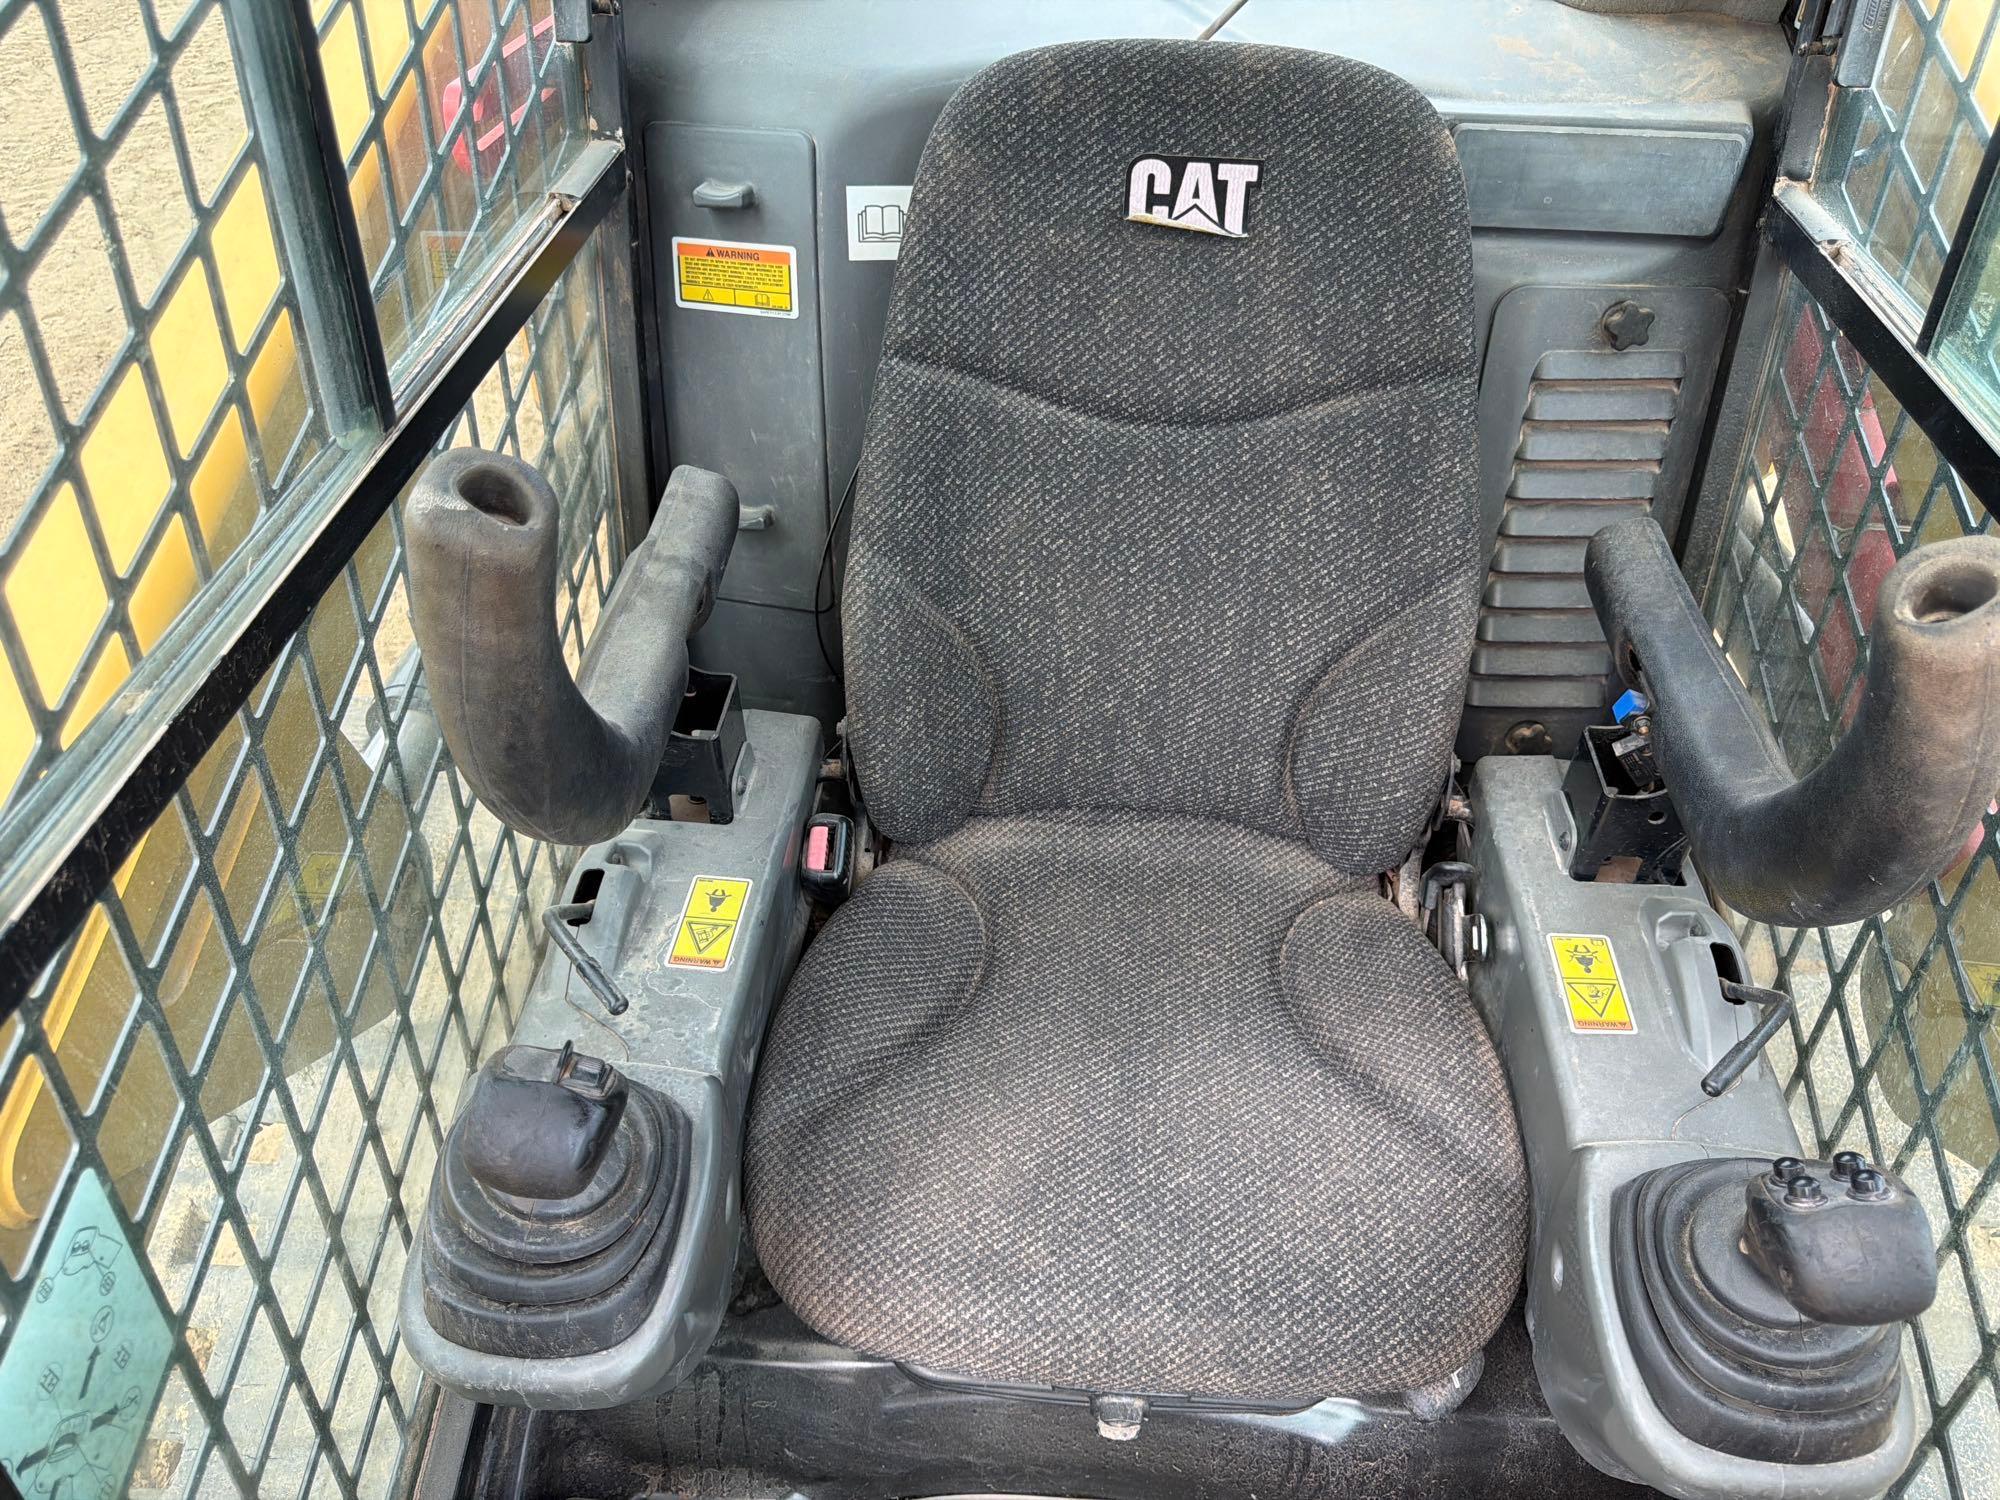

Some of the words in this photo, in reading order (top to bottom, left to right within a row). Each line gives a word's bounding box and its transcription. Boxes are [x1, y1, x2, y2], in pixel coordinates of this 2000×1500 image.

[1129, 158, 1259, 236] CAT
[716, 249, 760, 261] WARNING
[673, 956, 711, 965] WARNING
[1577, 1020, 1618, 1028] WARNING
